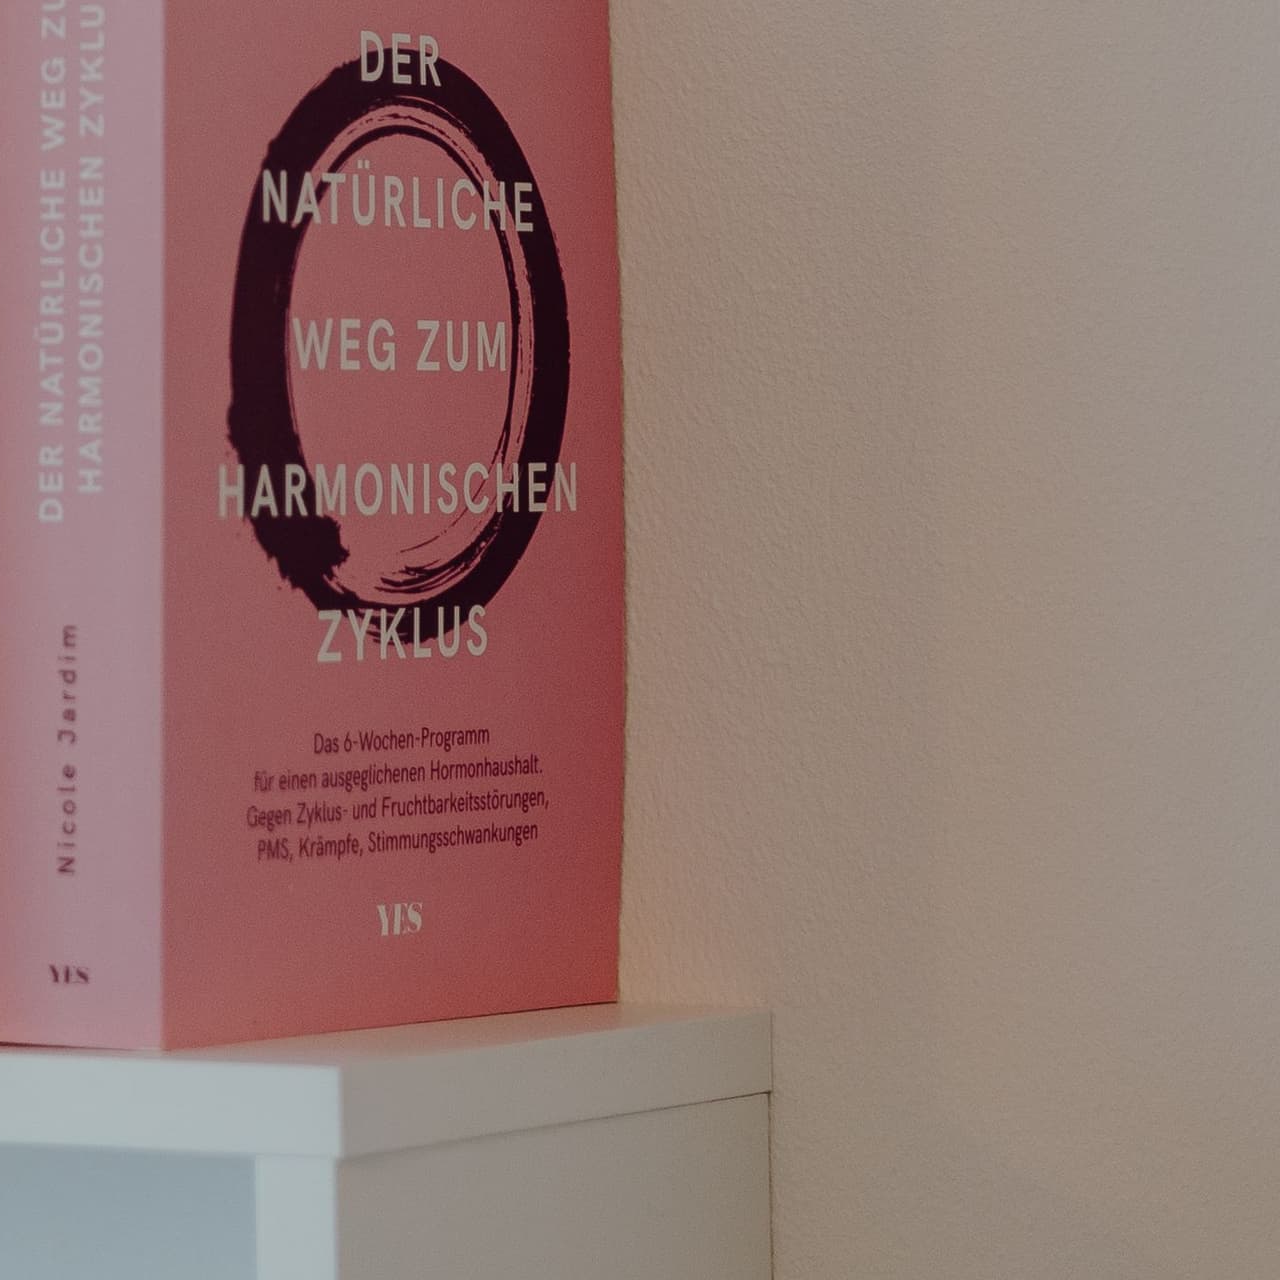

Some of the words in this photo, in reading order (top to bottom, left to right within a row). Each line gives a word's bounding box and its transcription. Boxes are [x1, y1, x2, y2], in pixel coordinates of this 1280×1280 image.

[359, 30, 442, 87] DER
[40, 56, 67, 152] WEG
[261, 159, 535, 233] NATÜRLICHE
[33, 167, 66, 426] NATÜRLICHE
[77, 155, 105, 495] HARMONISCHEN
[292, 317, 397, 372] WEG
[416, 319, 508, 372] ZUM
[38, 444, 64, 523] DER
[217, 461, 579, 518] HARMONISCHEN
[316, 604, 488, 664] ZYKLUS
[56, 624, 78, 746] Jardim
[313, 732, 340, 755] Das
[343, 726, 491, 755] 6-Wochen-Programm
[253, 770, 276, 793] für
[278, 772, 317, 792] einen
[321, 763, 426, 793] ausgeglichenen
[430, 753, 543, 782] Hormonhaushalt.
[56, 764, 77, 876] Nicole
[246, 804, 292, 832] Gegen
[296, 801, 348, 829] Zyklus-
[352, 797, 378, 820] und
[381, 788, 550, 819] Fruchtbarkeitsstörungen,
[257, 838, 293, 863] PMS,
[298, 832, 364, 860] Krämpfe,
[368, 822, 539, 854] Stimmungsschwankungen
[376, 901, 424, 937] YES
[48, 963, 91, 985] YES
